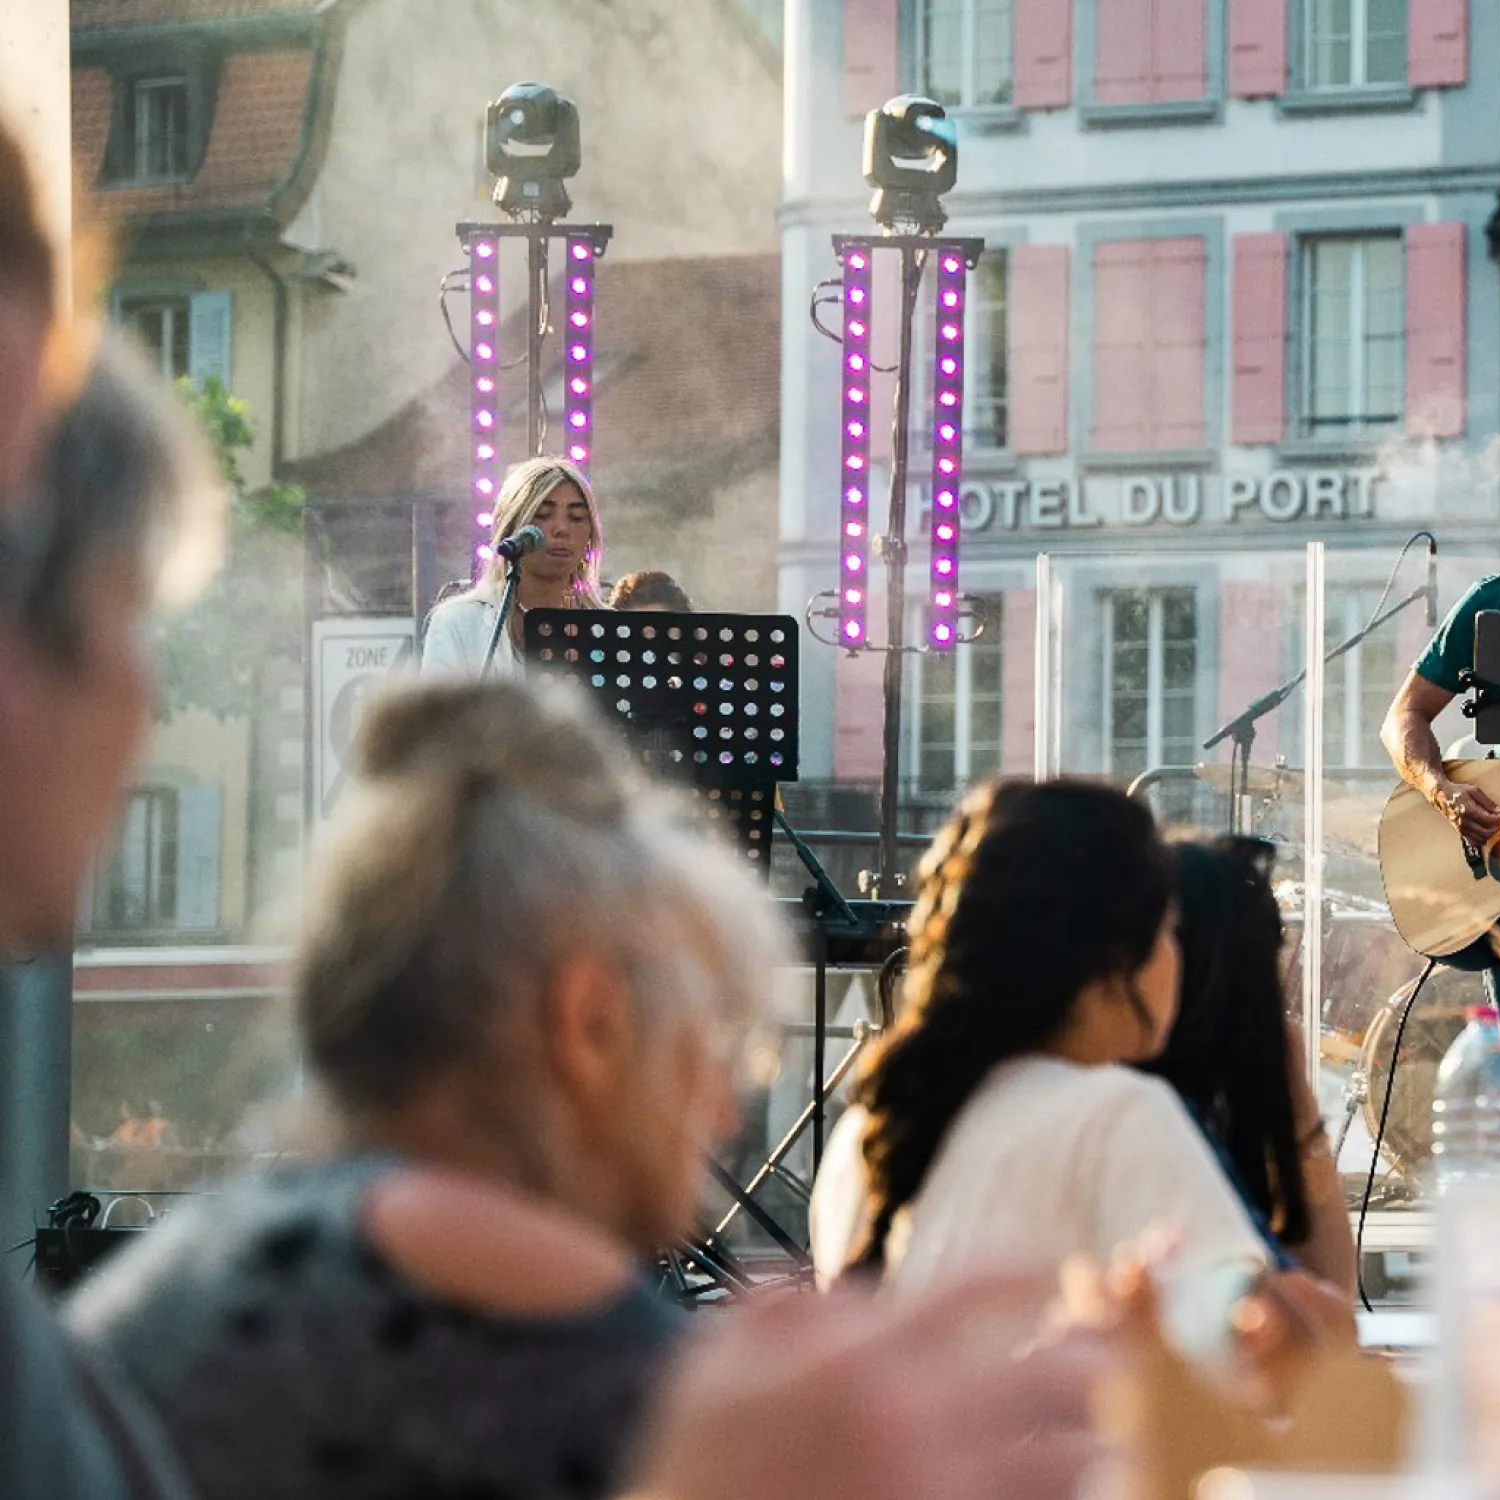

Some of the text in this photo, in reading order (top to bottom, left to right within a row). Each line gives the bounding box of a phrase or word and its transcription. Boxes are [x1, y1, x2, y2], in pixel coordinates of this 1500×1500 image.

[1120, 474, 1201, 526] DU
[1223, 467, 1384, 523] PORT
[345, 646, 388, 669] ZONE
